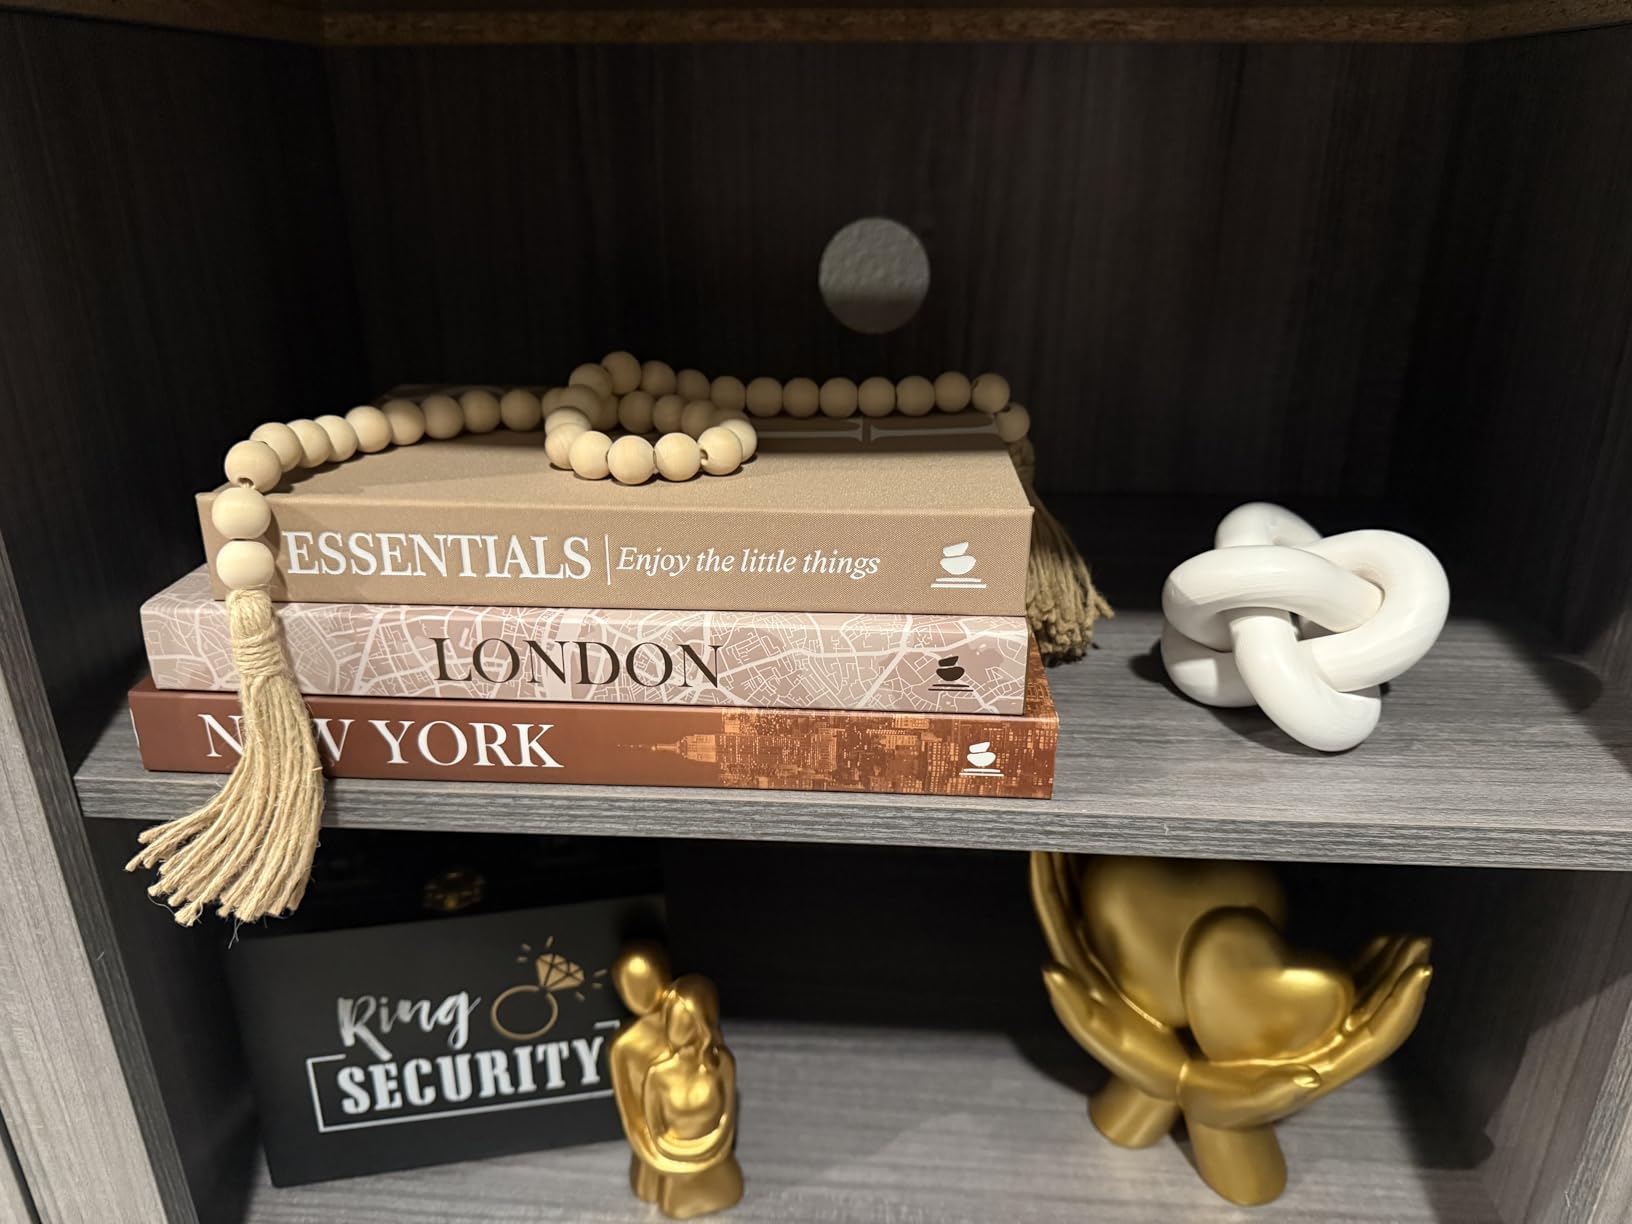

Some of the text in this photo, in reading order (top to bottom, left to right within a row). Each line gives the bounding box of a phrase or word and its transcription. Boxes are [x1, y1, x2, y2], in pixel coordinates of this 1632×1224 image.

[282, 530, 592, 581] ESSENTIALS
[616, 547, 881, 580] Enjoy the little things
[430, 637, 720, 689] LONDON
[197, 713, 565, 770] NW YORK
[337, 991, 481, 1060] Ring
[336, 1037, 604, 1115] SECURITY
